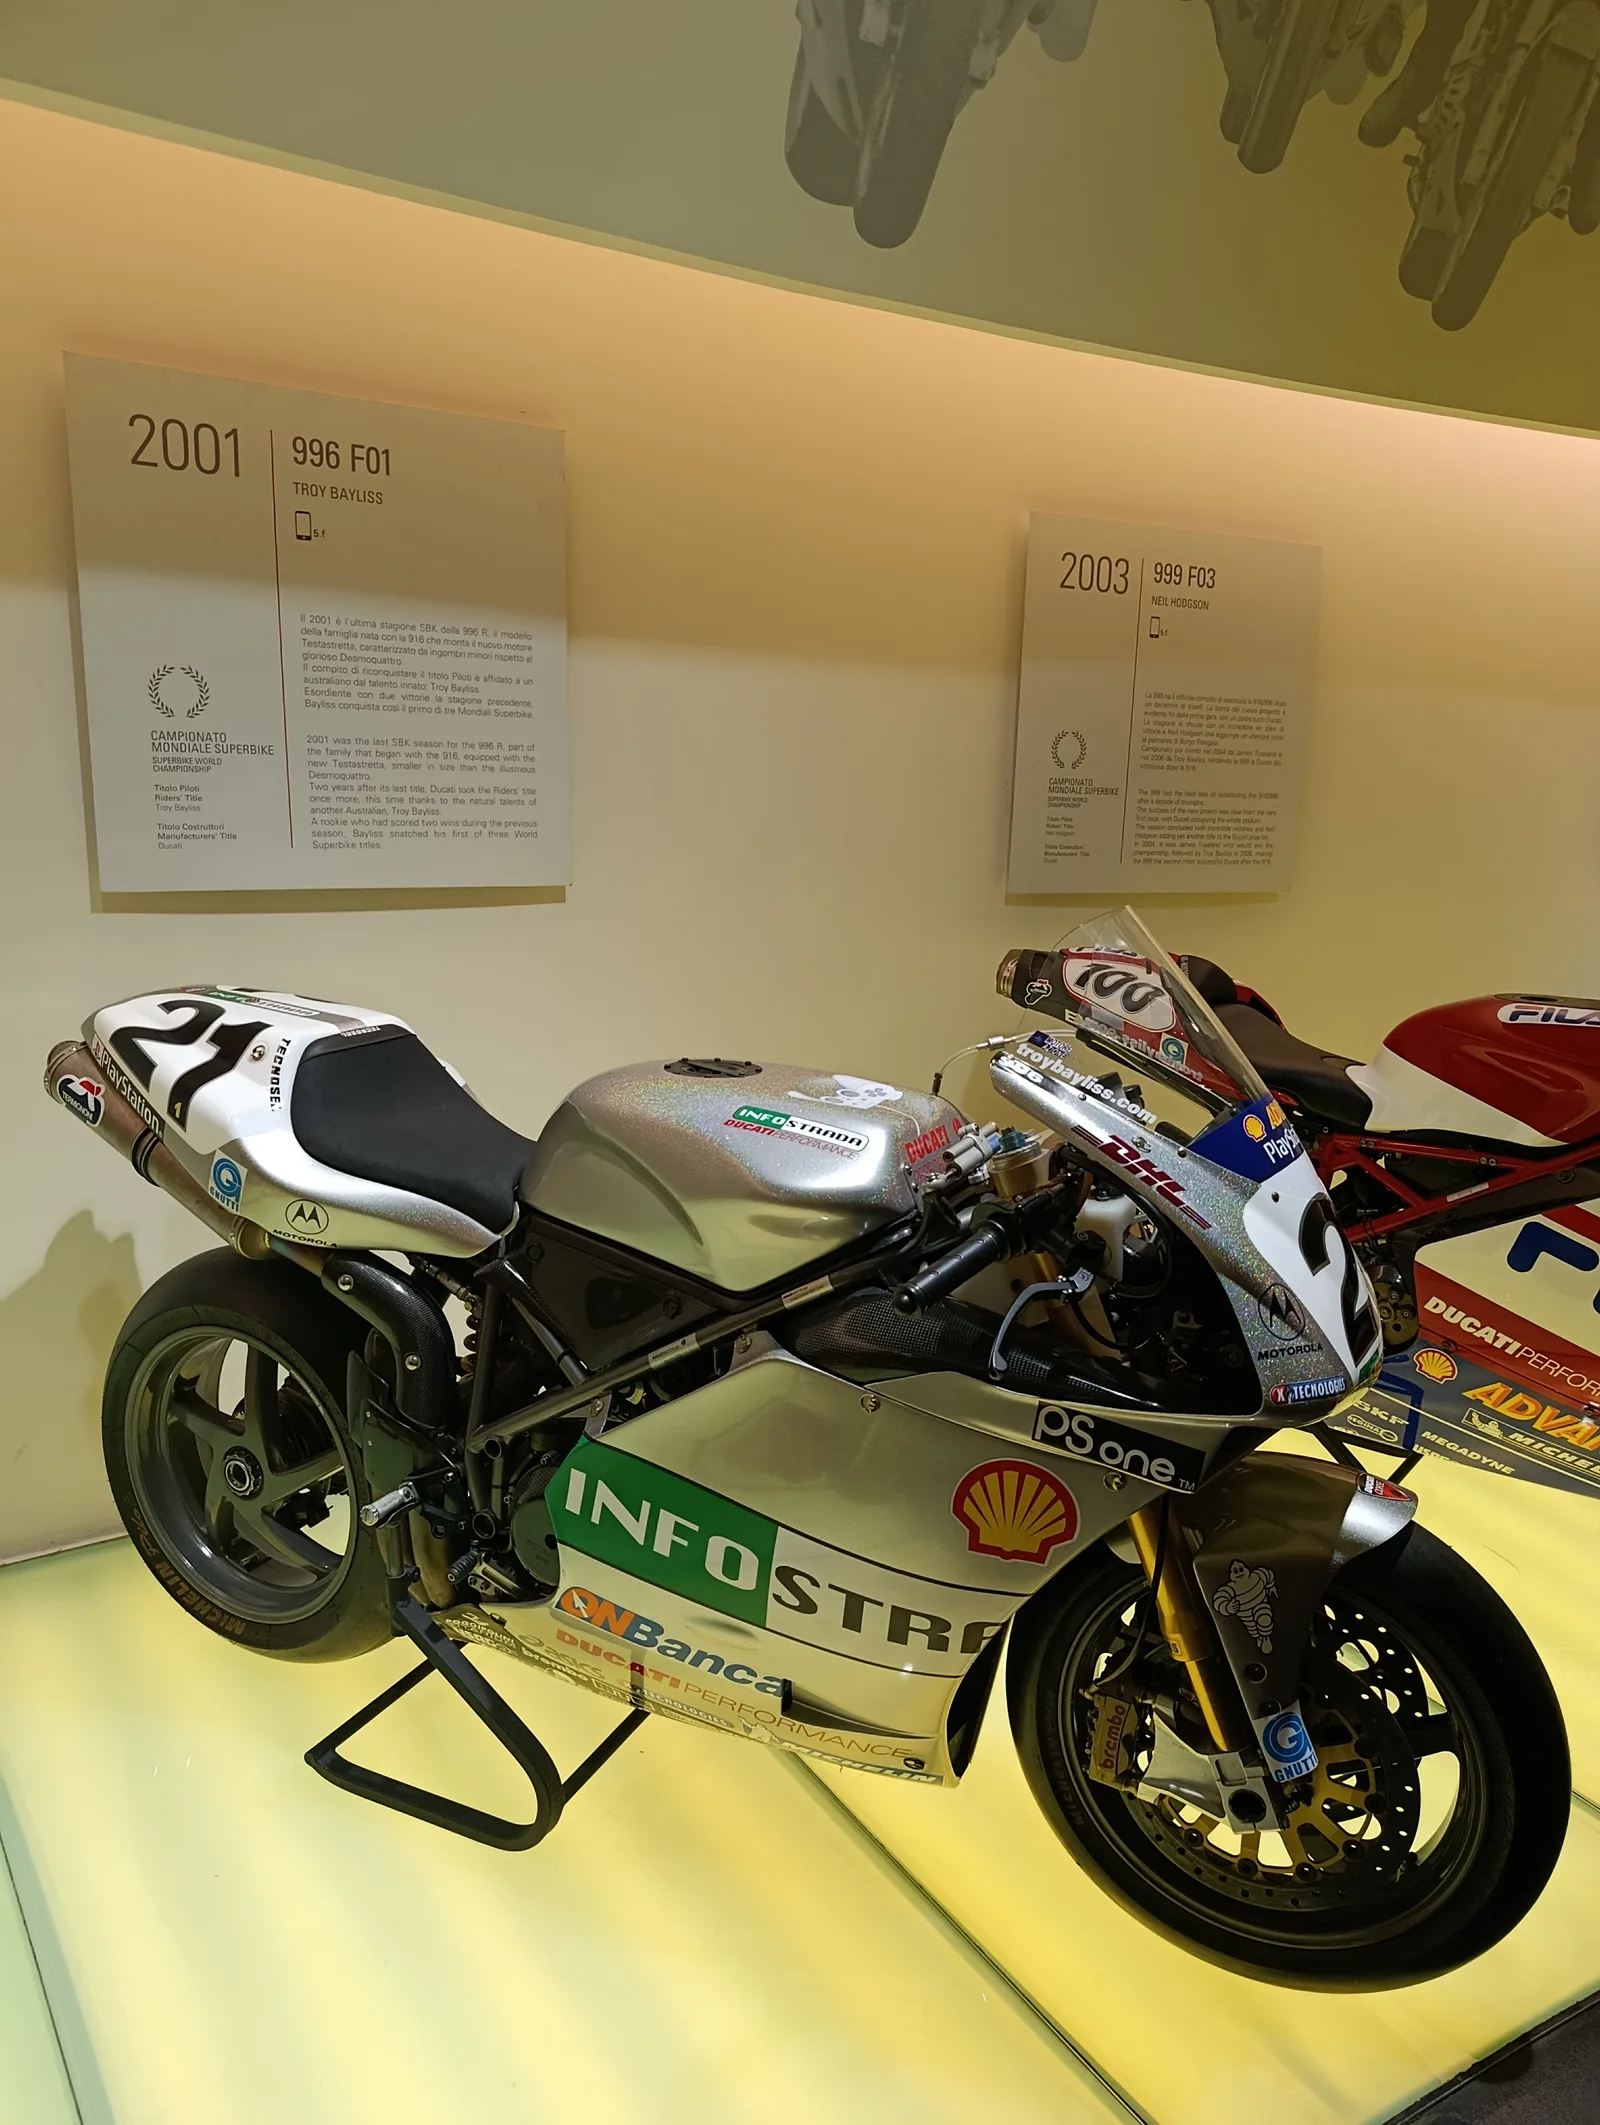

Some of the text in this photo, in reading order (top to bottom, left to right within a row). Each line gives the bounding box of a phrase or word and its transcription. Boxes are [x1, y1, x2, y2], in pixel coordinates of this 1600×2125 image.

[128, 413, 241, 478] 2001
[292, 435, 391, 476] 996 F01
[292, 481, 383, 505] TROY BAYLISS
[1060, 552, 1130, 595] 2003
[1153, 562, 1216, 589] 999 F03
[1151, 595, 1209, 610] NEIL HODGSON
[150, 730, 227, 743] CAMPIONATO
[306, 734, 328, 744] 2001
[332, 737, 351, 745] was
[355, 736, 369, 746] the
[372, 736, 388, 746] last
[391, 737, 410, 747] SBK
[413, 740, 443, 748] season
[446, 739, 458, 749] for
[461, 739, 475, 749] the
[478, 740, 494, 750] 996
[508, 741, 523, 753] part
[151, 742, 274, 755] MONDIALE SUPERBIKE
[307, 746, 321, 756] the
[325, 746, 351, 759] family
[355, 747, 371, 757] that
[375, 748, 401, 761] began
[404, 749, 422, 759] with
[425, 749, 439, 759] the
[463, 751, 499, 764] equipped
[502, 752, 519, 762] with
[522, 752, 535, 762] the
[152, 756, 222, 765] SUPERBIKE WORLD
[152, 765, 212, 773] CHAMPIONSHIP
[307, 760, 327, 768] new
[391, 760, 421, 770] smaller
[438, 761, 455, 771] size
[459, 762, 477, 772] than
[481, 763, 495, 772] the
[499, 763, 535, 774] illustrious
[154, 784, 200, 792] Titolo Piloti
[309, 781, 328, 791] Two
[331, 784, 354, 794] years
[357, 782, 376, 792] after
[379, 783, 389, 792] its
[392, 783, 406, 793] last
[430, 784, 455, 794] Ducati
[458, 784, 475, 794] took
[478, 784, 490, 794] the
[521, 785, 536, 795] title
[1048, 777, 1093, 787] CAMPIONATO
[1048, 786, 1119, 796] MONDIALE SUPERBIKE
[155, 803, 201, 812] Troy Bayliss
[185, 794, 203, 802] Title
[309, 795, 331, 803] once
[365, 794, 381, 803] this
[385, 794, 404, 804] time
[408, 794, 435, 804] thanks
[452, 795, 465, 805] the
[469, 795, 495, 805] natural
[499, 796, 524, 806] talents
[310, 804, 343, 814] another
[391, 805, 409, 818] Troy
[182, 823, 225, 831] Costruttori
[320, 816, 348, 826] rookie
[350, 817, 369, 826] who
[371, 817, 388, 826] had
[390, 817, 419, 827] scored
[421, 817, 438, 827] two
[439, 817, 459, 827] wins
[461, 817, 487, 830] during
[488, 818, 502, 827] the
[504, 818, 537, 830] previous
[219, 832, 237, 840] Title
[352, 828, 383, 840] Bayliss
[389, 828, 428, 838] snatched
[433, 828, 446, 838] his
[452, 828, 467, 838] first
[488, 828, 508, 838] three
[513, 829, 537, 838] World
[158, 842, 183, 850] Ducati
[312, 839, 356, 851] Superbike
[109, 999, 275, 1133] 21
[270, 1038, 292, 1112] TECNOSE
[101, 1049, 160, 1134] PlayStation
[1016, 1043, 1157, 1125] troybayliss.com
[738, 1108, 863, 1148] INFOSTRADA
[904, 1124, 951, 1165] DUCATI
[1097, 1134, 1187, 1206] DHL
[209, 1186, 239, 1212] GNUTTI
[273, 1228, 338, 1248] MOTOROLA
[1257, 1343, 1324, 1361] MOTOROLA
[1423, 1296, 1600, 1399] DUCATI PERFOR
[1353, 1400, 1410, 1425] SKF
[1099, 1440, 1176, 1482] one
[1421, 1430, 1516, 1475] MEGADYNE
[154, 1560, 248, 1636] MICHELIN
[521, 1648, 589, 1682] brembo
[556, 1628, 681, 1689] DUCATI
[682, 1681, 913, 1759] PERFORMANCE
[1100, 1704, 1126, 1770] brembo
[778, 1739, 937, 1784] MICHELIN
